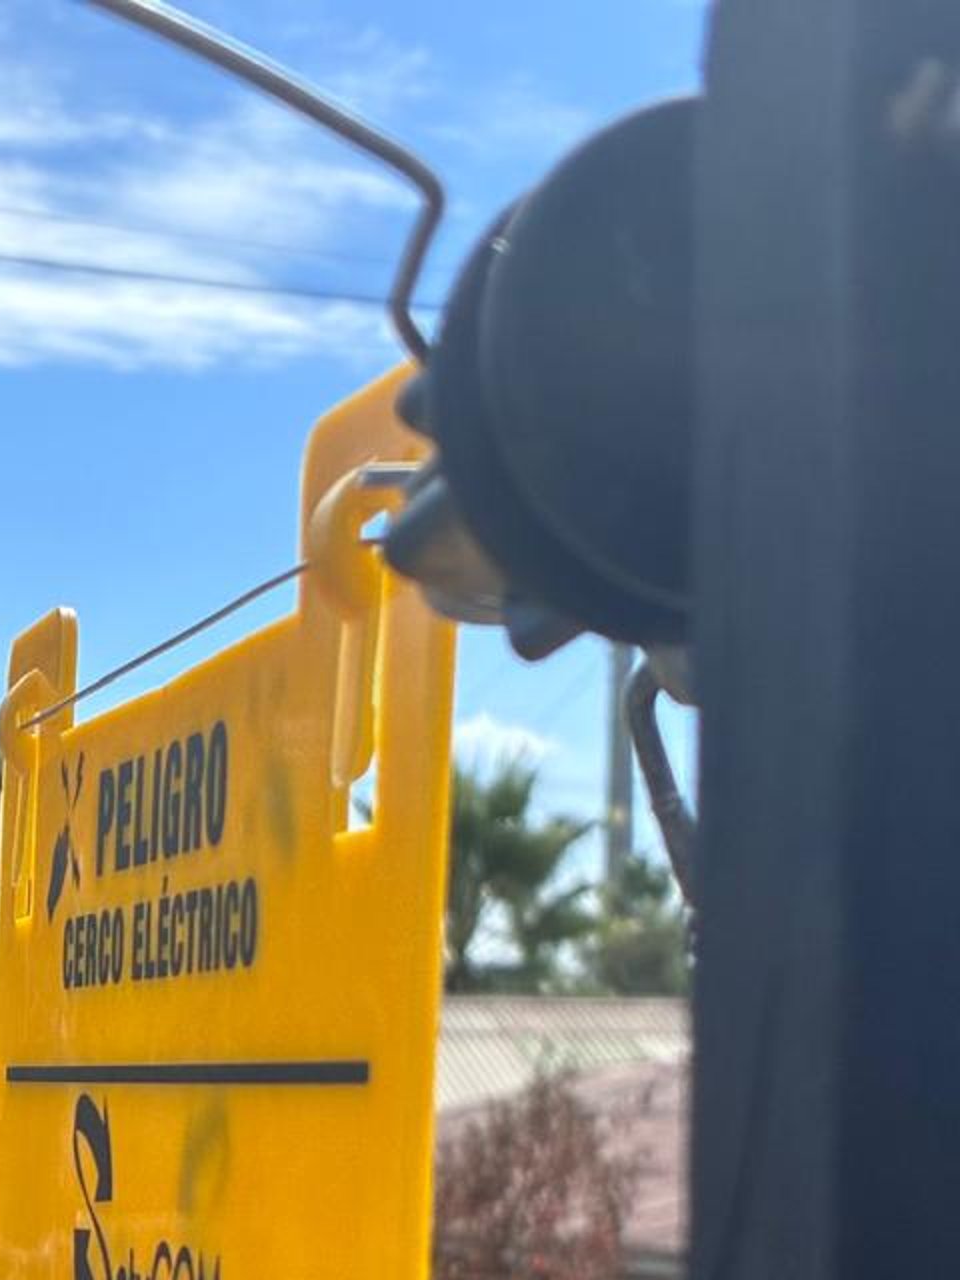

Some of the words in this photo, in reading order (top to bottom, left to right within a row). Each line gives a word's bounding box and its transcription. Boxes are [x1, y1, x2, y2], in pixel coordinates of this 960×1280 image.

[95, 720, 228, 876] PELIGRO
[62, 907, 124, 989] CERCO
[130, 876, 259, 982] ELÉCTRICO
